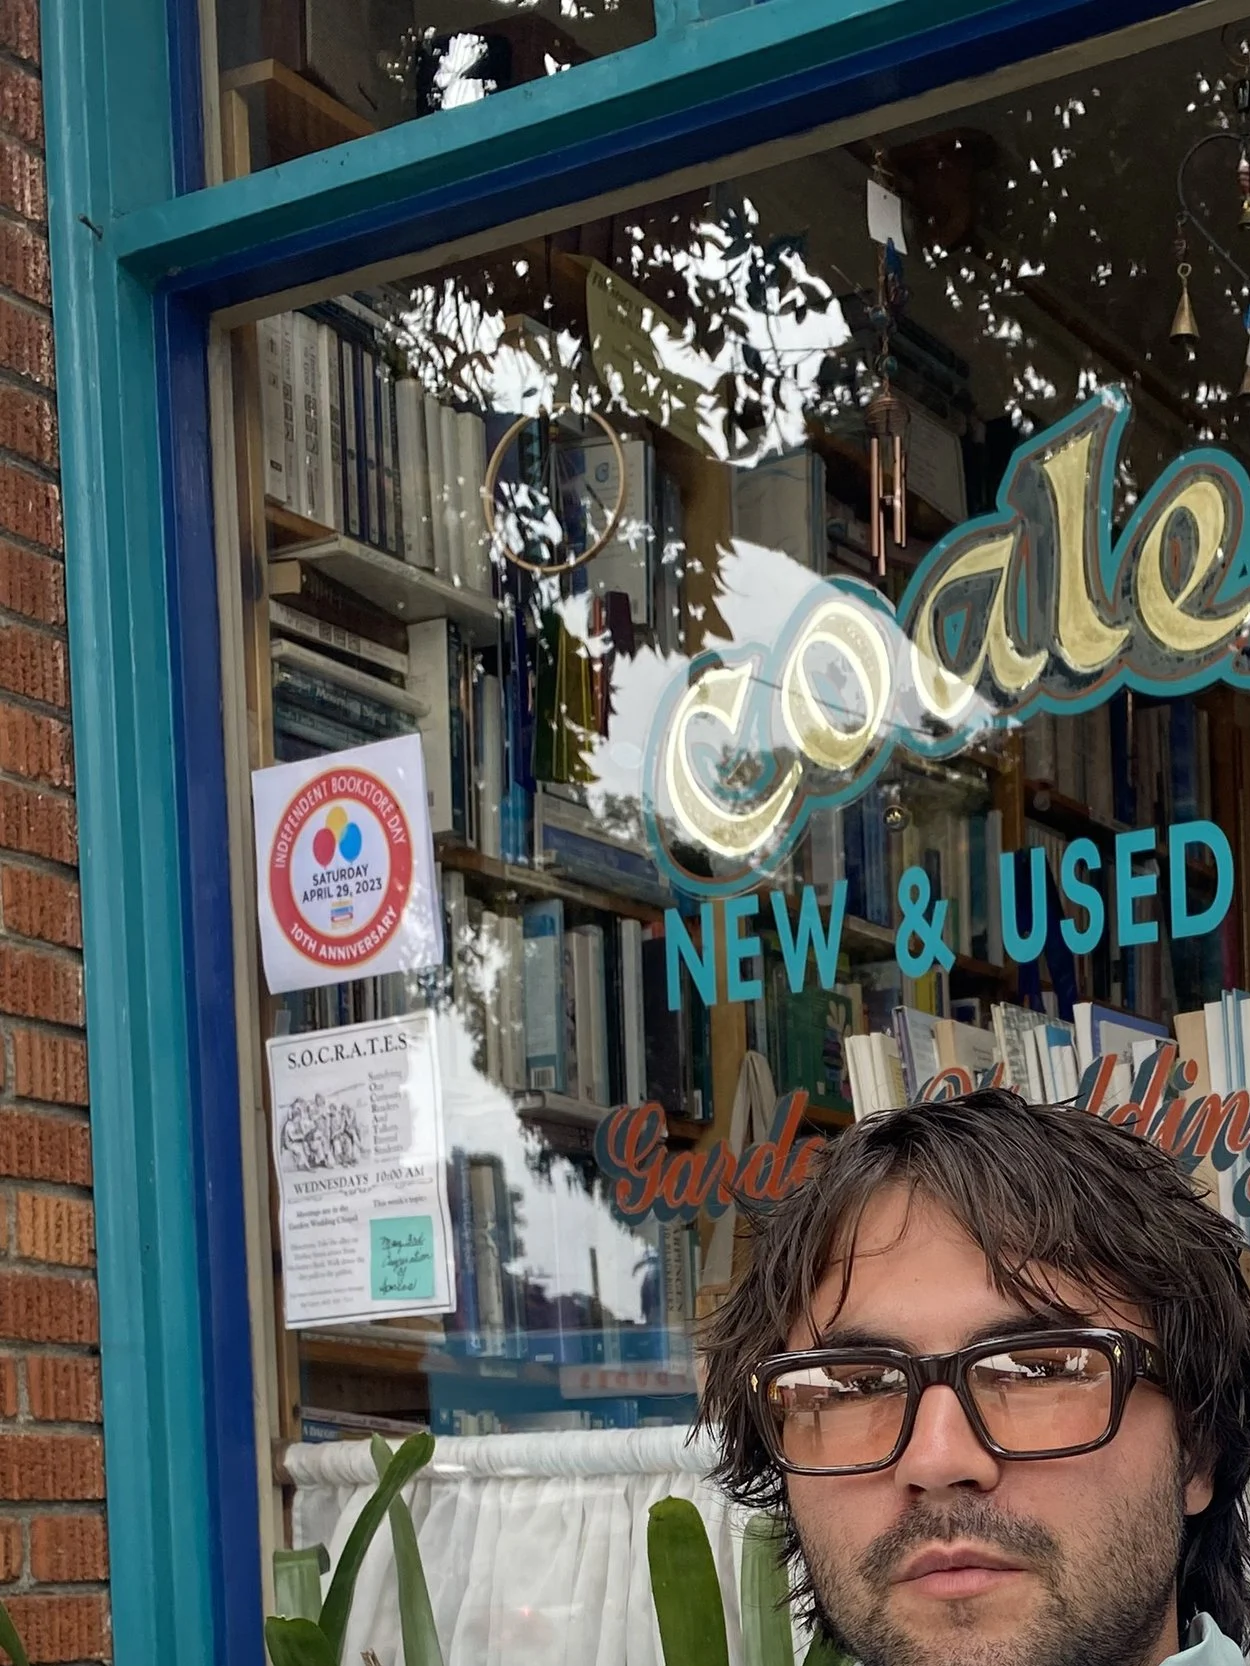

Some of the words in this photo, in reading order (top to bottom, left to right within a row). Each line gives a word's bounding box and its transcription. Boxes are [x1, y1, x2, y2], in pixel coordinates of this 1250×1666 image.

[274, 783, 329, 868] INDEPENDENT
[331, 776, 396, 819] BOOKSTORE
[389, 815, 407, 845] DAY
[302, 887, 333, 903] APRIL
[336, 883, 353, 898] 29,
[355, 878, 382, 895] 2023
[312, 863, 369, 885] SATURDAY
[290, 923, 317, 953] 10TH
[319, 905, 398, 960] ANNIVERSARY
[665, 879, 848, 1011] NEW
[896, 866, 955, 978] &
[1000, 820, 1234, 963] USED
[607, 1090, 827, 1214] Gard
[293, 1173, 369, 1195] WEDNESDAYS
[375, 1169, 402, 1183] 10:00
[405, 1165, 424, 1178] AM
[310, 1218, 336, 1228] Wedding
[336, 1214, 358, 1225] Chapel
